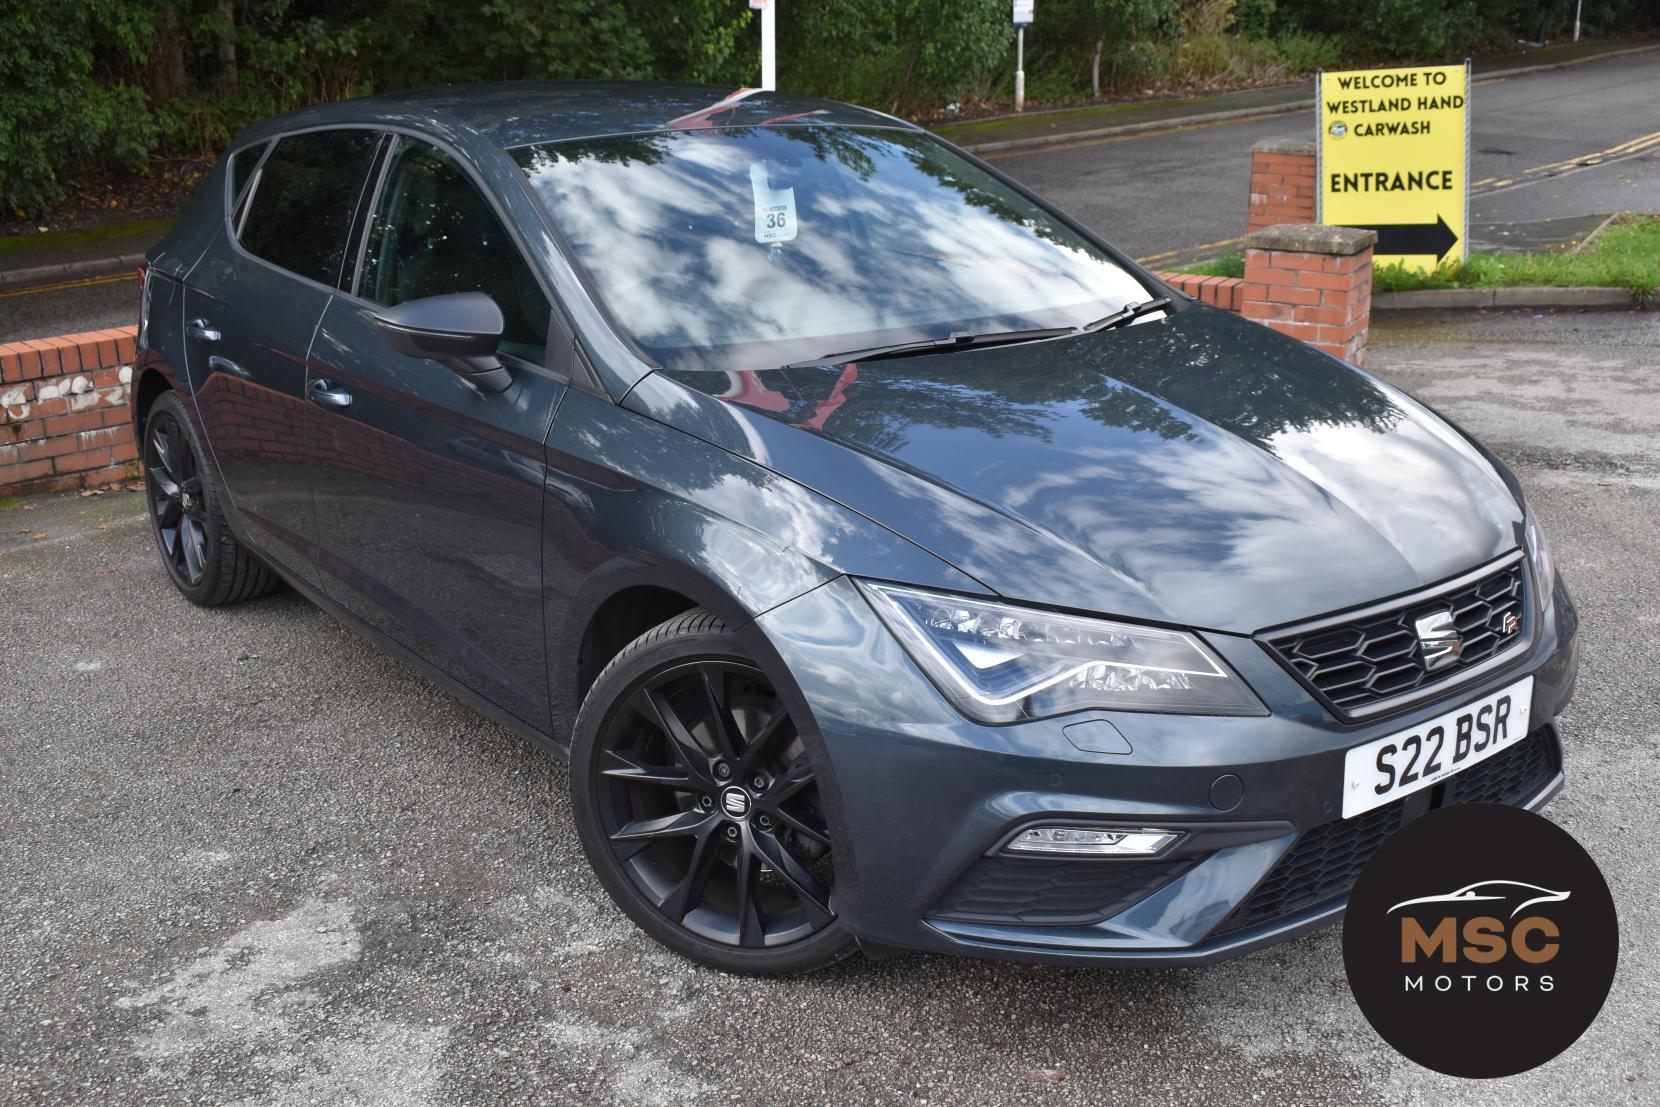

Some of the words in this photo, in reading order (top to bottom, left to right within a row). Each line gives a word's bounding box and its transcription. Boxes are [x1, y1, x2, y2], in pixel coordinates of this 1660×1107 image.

[1337, 73, 1418, 90] WELCOME
[1423, 71, 1447, 86] TO
[1326, 97, 1412, 114] WESTLAND
[1417, 95, 1465, 111] HAND
[1353, 121, 1431, 137] CARWASH
[1330, 170, 1453, 192] ENTRANCE
[766, 212, 786, 228] 36
[1374, 725, 1445, 795] S22
[1452, 694, 1512, 764] BSR
